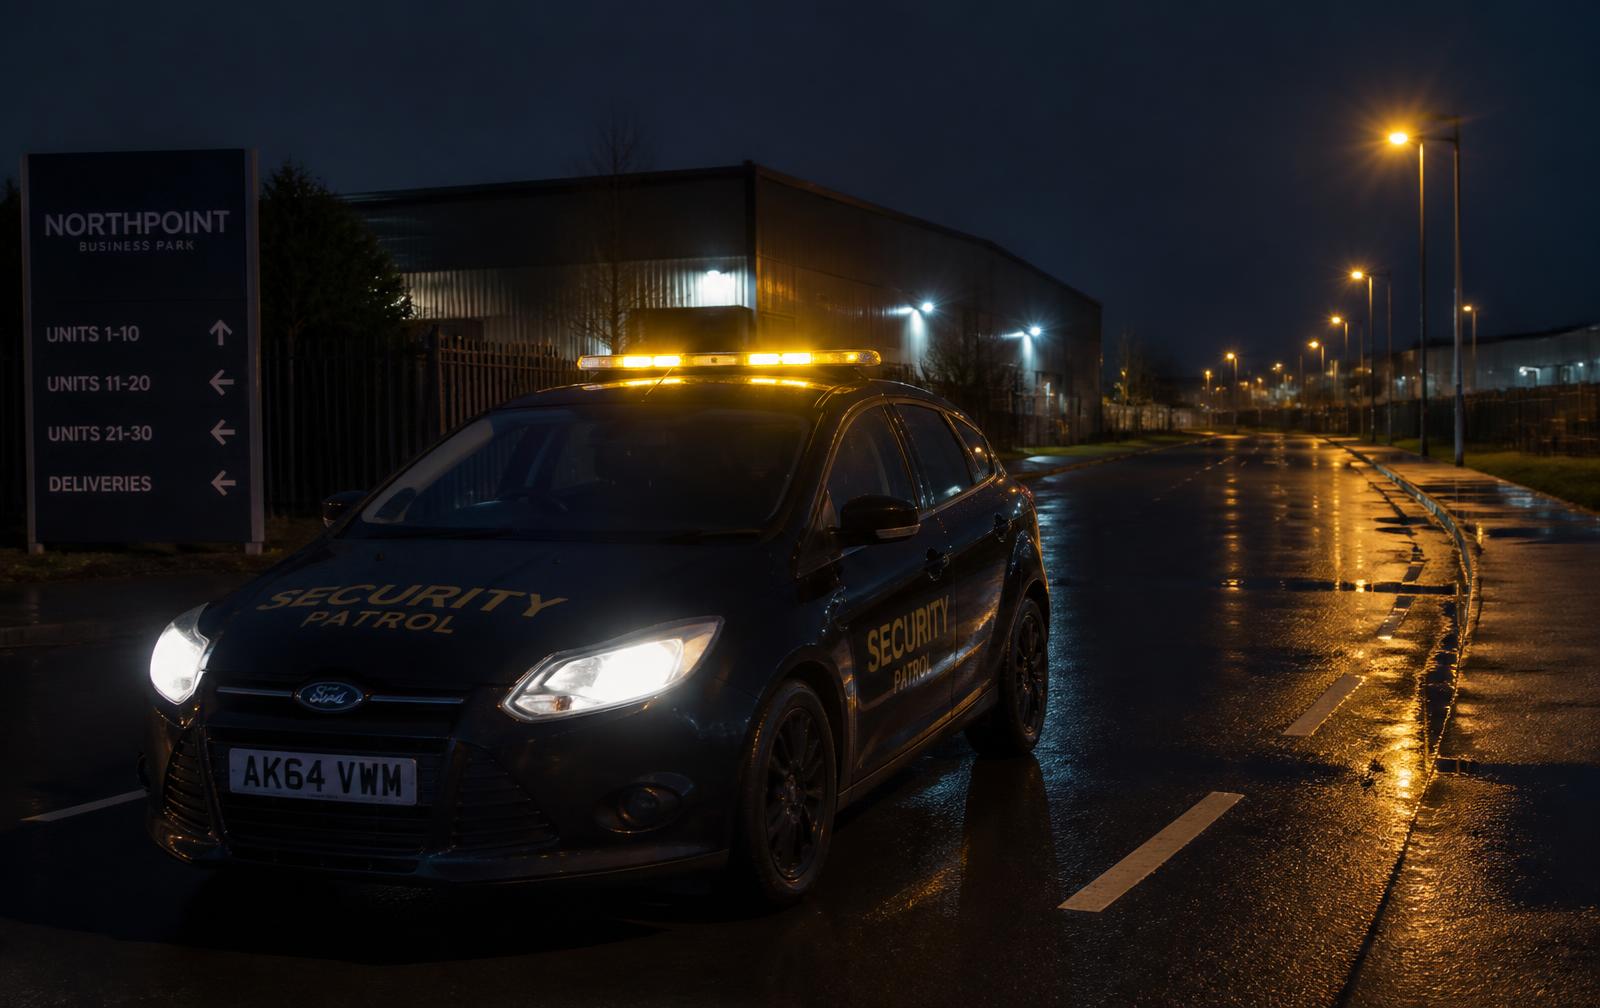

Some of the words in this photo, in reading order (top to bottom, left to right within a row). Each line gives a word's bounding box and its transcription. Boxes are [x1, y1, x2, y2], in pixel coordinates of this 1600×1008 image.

[45, 210, 230, 236] NORTHPOINT
[79, 240, 150, 252] BUSINESS
[157, 239, 195, 251] PARK
[46, 326, 100, 342] UNITS
[105, 325, 140, 342] 1-10
[47, 375, 100, 392] UNITS
[105, 375, 151, 392] 11-20
[48, 425, 101, 442] UNITS
[106, 425, 153, 442] 21-30
[49, 475, 152, 492] DELIVERIES
[256, 583, 568, 619] SECURITY
[300, 609, 456, 635] PATROL
[866, 594, 950, 673] SECURITY
[893, 652, 932, 694] PATROL
[308, 684, 348, 706] Ford
[243, 755, 326, 792] AK64
[338, 760, 402, 797] VWM
